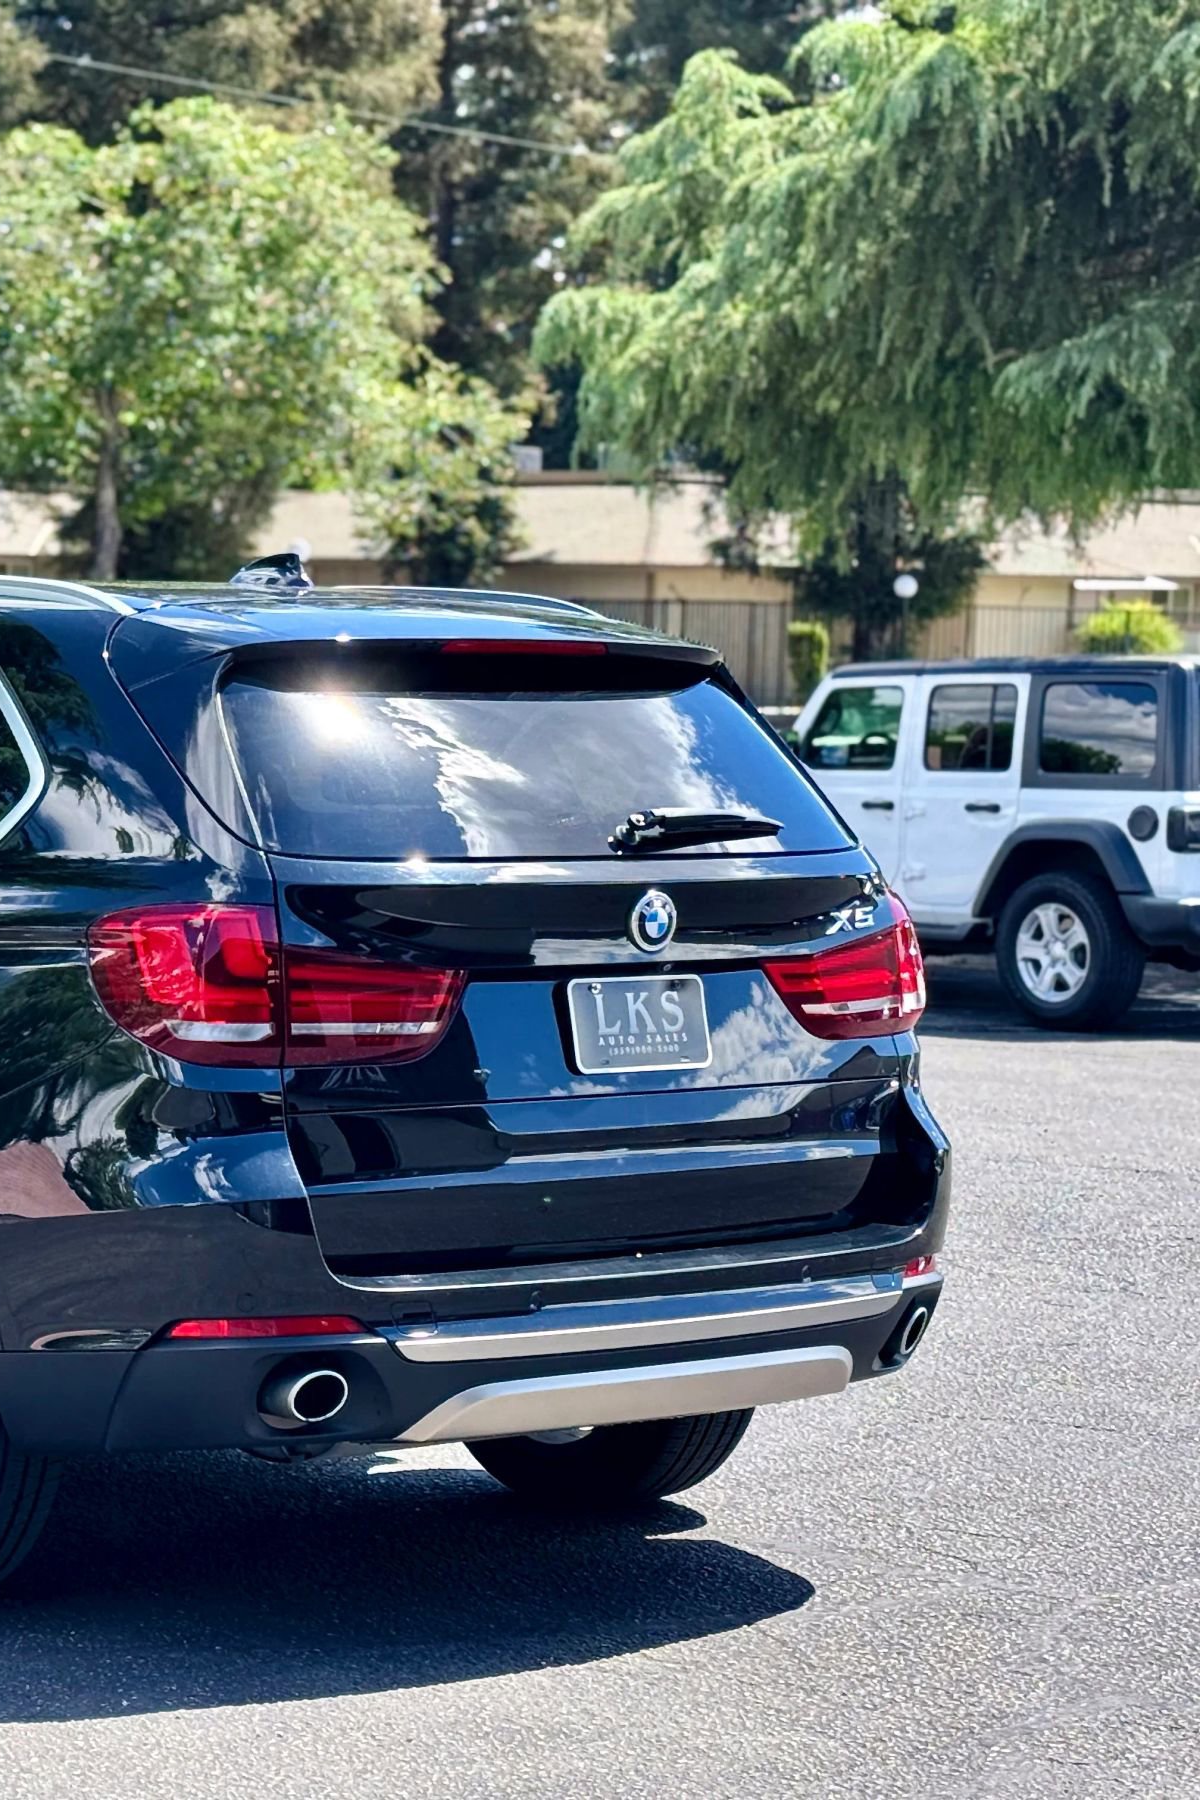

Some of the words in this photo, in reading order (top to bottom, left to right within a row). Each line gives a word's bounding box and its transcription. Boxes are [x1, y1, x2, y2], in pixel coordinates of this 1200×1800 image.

[825, 906, 874, 935] X5
[594, 990, 685, 1035] LKS
[598, 1035, 636, 1046] AUTO
[646, 1032, 688, 1043] SALES
